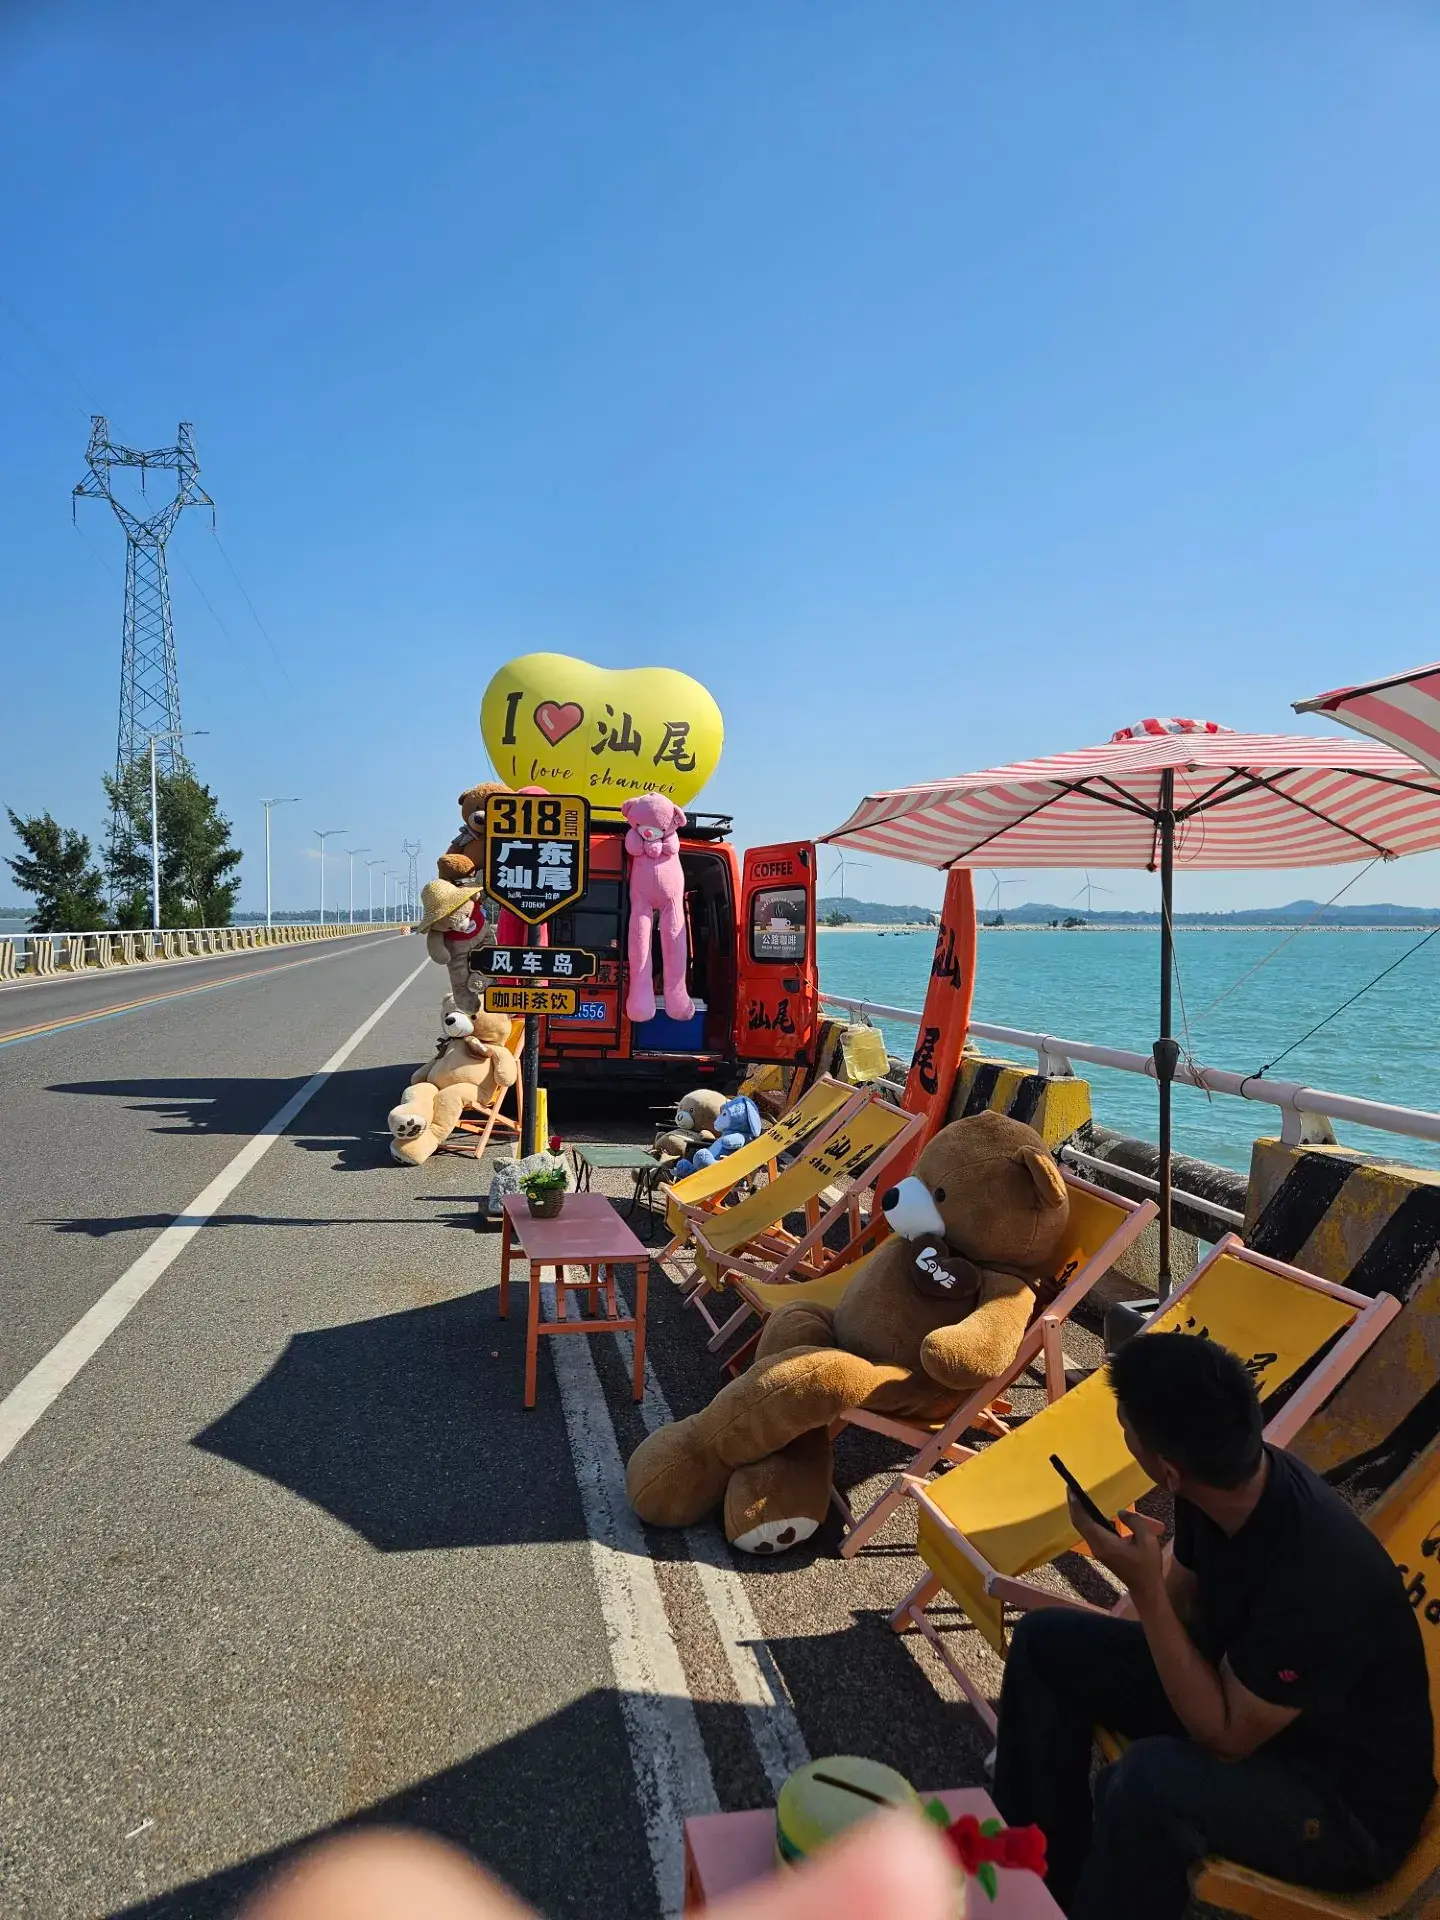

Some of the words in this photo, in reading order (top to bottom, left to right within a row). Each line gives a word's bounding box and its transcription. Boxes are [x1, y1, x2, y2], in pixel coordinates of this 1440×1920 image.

[502, 692, 523, 745] I
[591, 704, 696, 772] 汕尾
[531, 756, 573, 781] love
[590, 768, 676, 794] shanwei
[493, 799, 561, 835] 318
[565, 810, 578, 836] ROUTE
[496, 840, 573, 865] 广东
[496, 865, 572, 890] 汕尾
[754, 861, 793, 878] COFFEE
[762, 934, 797, 945] 公路咖啡
[490, 950, 573, 975] 风车岛
[492, 991, 568, 1010] 咖啡茶饮
[749, 998, 796, 1034] 汕尾
[808, 1157, 832, 1176] shan
